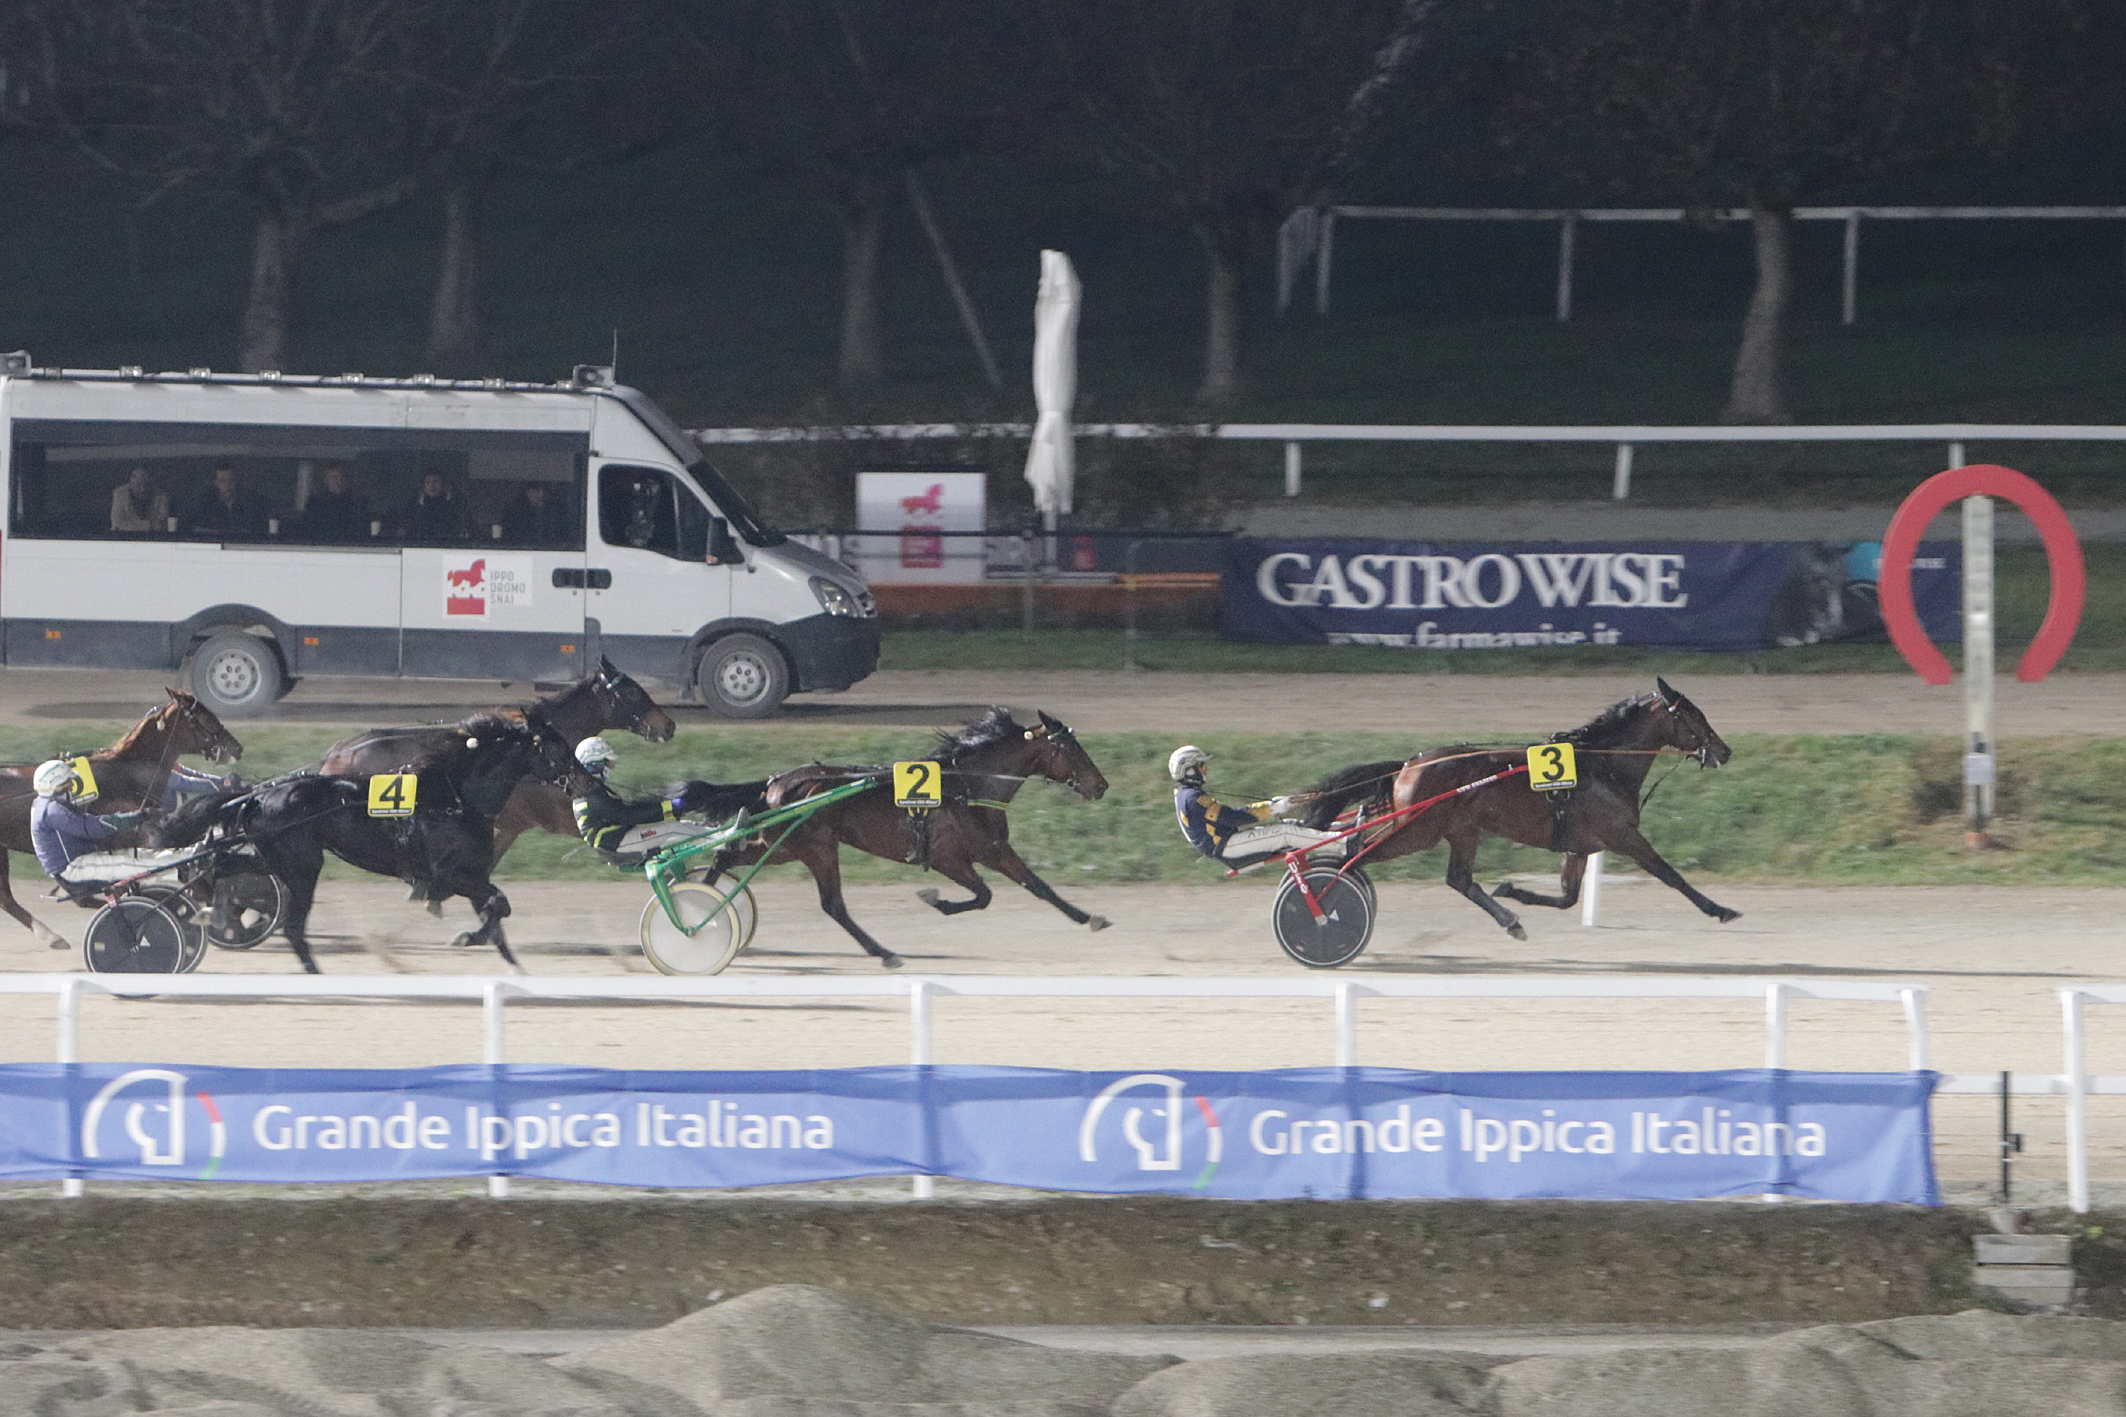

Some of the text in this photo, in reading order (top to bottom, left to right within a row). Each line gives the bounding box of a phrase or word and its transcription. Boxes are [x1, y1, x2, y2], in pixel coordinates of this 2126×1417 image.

[489, 570, 515, 581] IPPO
[489, 582, 526, 594] DROMO
[1257, 553, 1688, 608] GASTROWISE
[489, 594, 515, 605] SNAI
[1327, 621, 1622, 647] wwwfarmawiseit
[906, 763, 931, 799] 2
[1541, 746, 1565, 781] 3
[379, 774, 406, 809] 4
[252, 1099, 834, 1160] Grande Ippica Italiana
[1249, 1104, 1826, 1162] Grande Ippica Italiana
